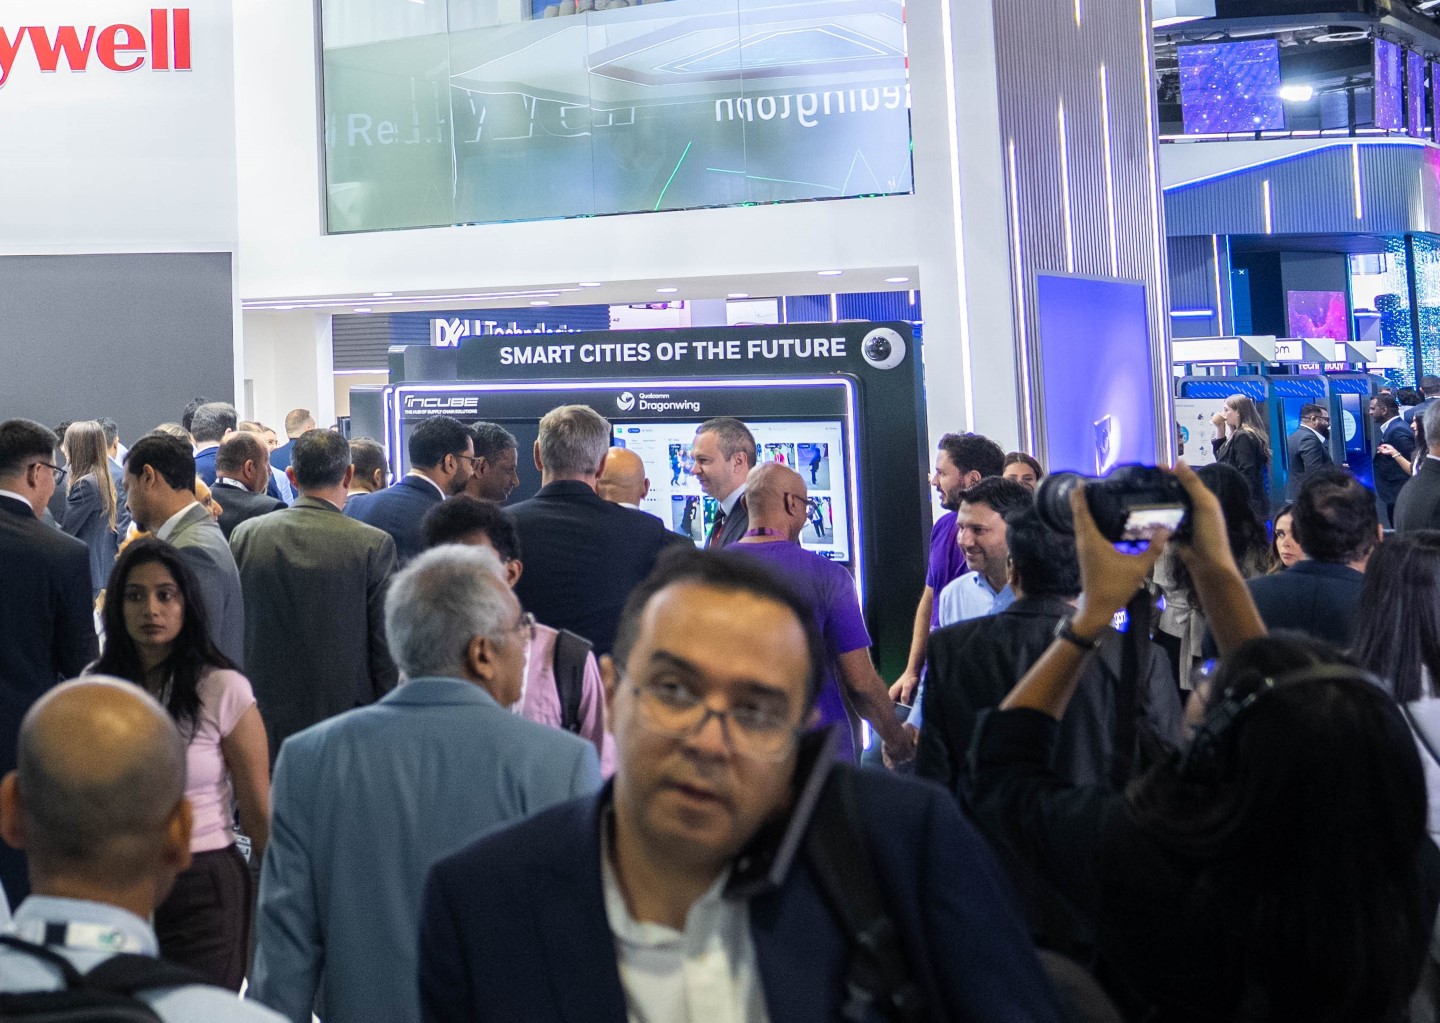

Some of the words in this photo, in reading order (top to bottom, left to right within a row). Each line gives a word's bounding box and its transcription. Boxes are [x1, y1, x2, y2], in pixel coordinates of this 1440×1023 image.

[499, 345, 575, 365] SMART
[579, 342, 651, 363] CITIES
[656, 342, 688, 361] OF
[692, 340, 742, 360] THE
[747, 337, 847, 359] FUTURE
[638, 392, 670, 400] Qualcomm
[638, 399, 701, 412] Dragonwing
